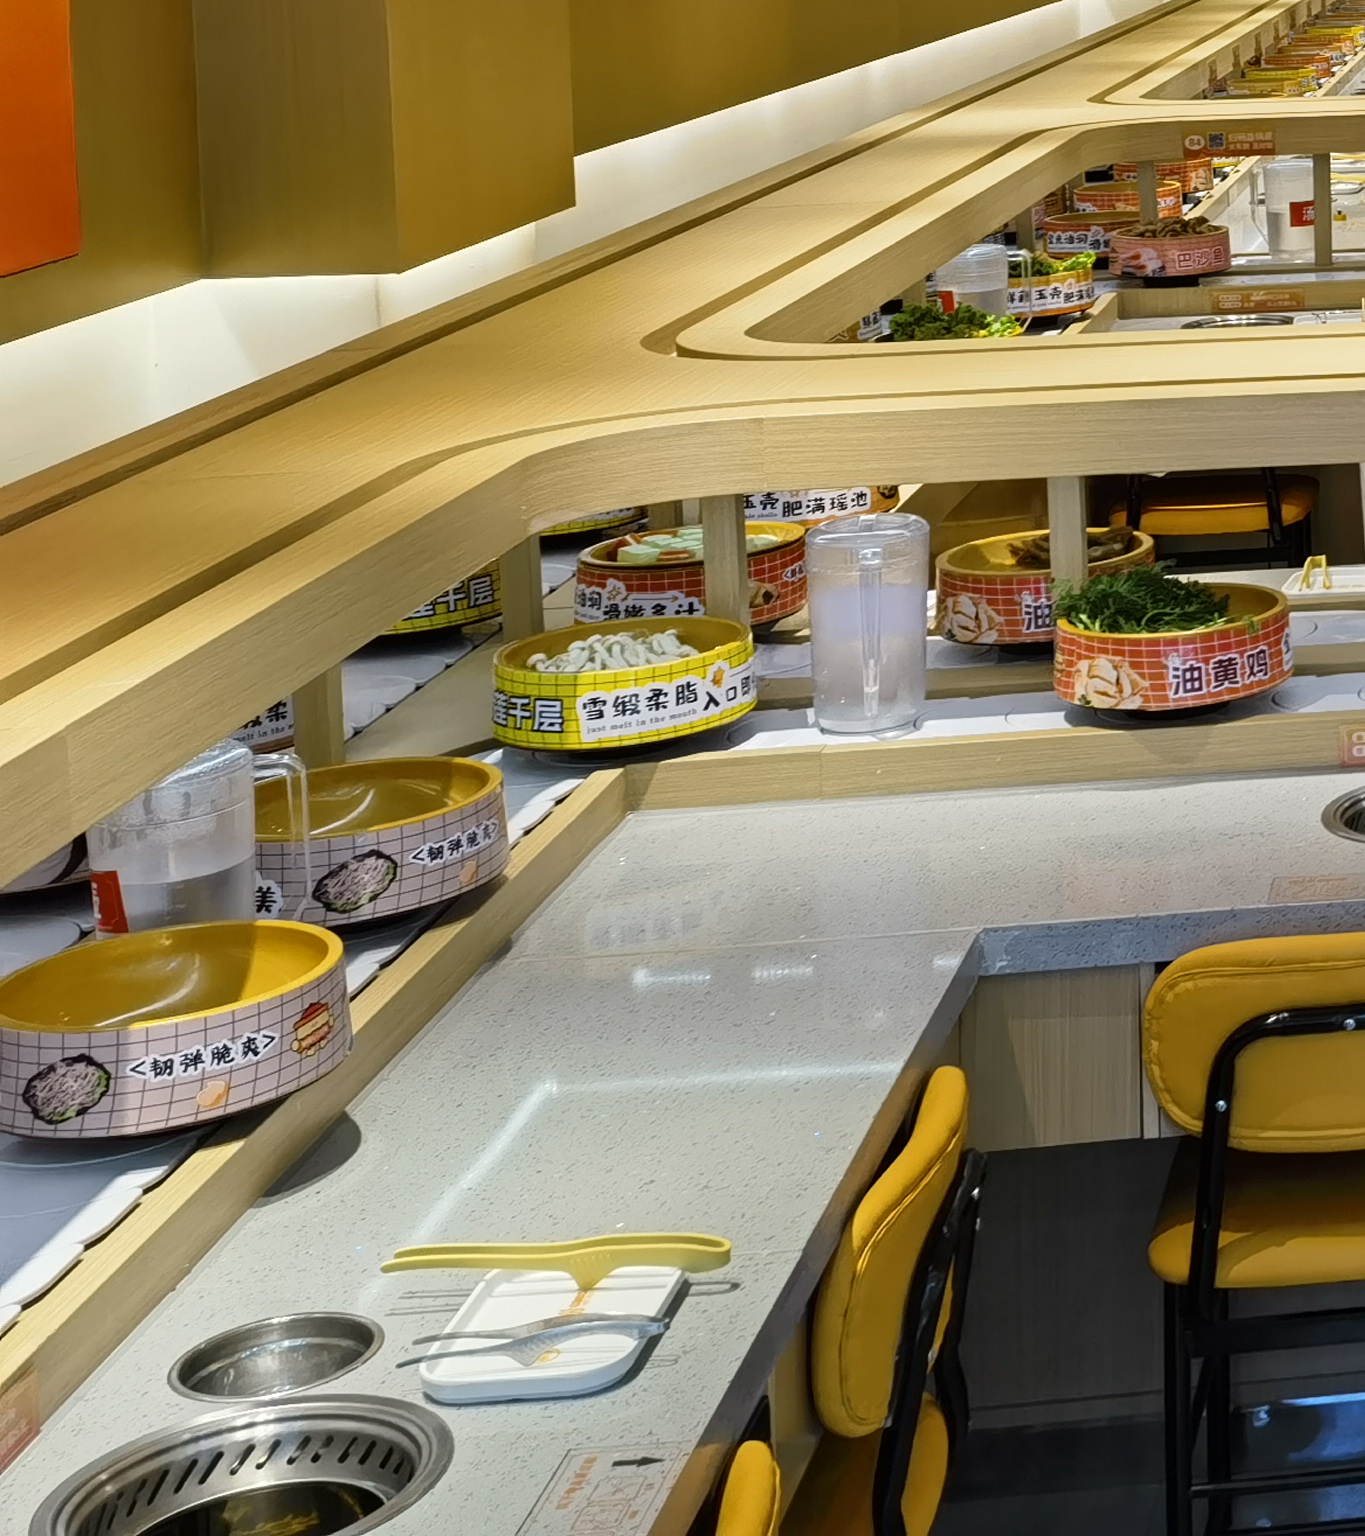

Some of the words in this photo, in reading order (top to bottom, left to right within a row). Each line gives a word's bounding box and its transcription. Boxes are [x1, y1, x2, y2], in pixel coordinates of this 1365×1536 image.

[1189, 138, 1202, 147] 84
[1175, 246, 1225, 270] 巴沙鱼
[782, 490, 868, 518] 肥满瑶池
[1170, 646, 1269, 698] 油黄鸡
[581, 680, 699, 722] 雪缎柔脂
[702, 672, 756, 712] 入口即
[586, 724, 607, 735] just
[636, 717, 647, 726] in
[649, 714, 666, 725] the
[668, 708, 698, 722] mouth
[255, 885, 278, 914] 美
[128, 1033, 279, 1079] <韧弹脆爽>
